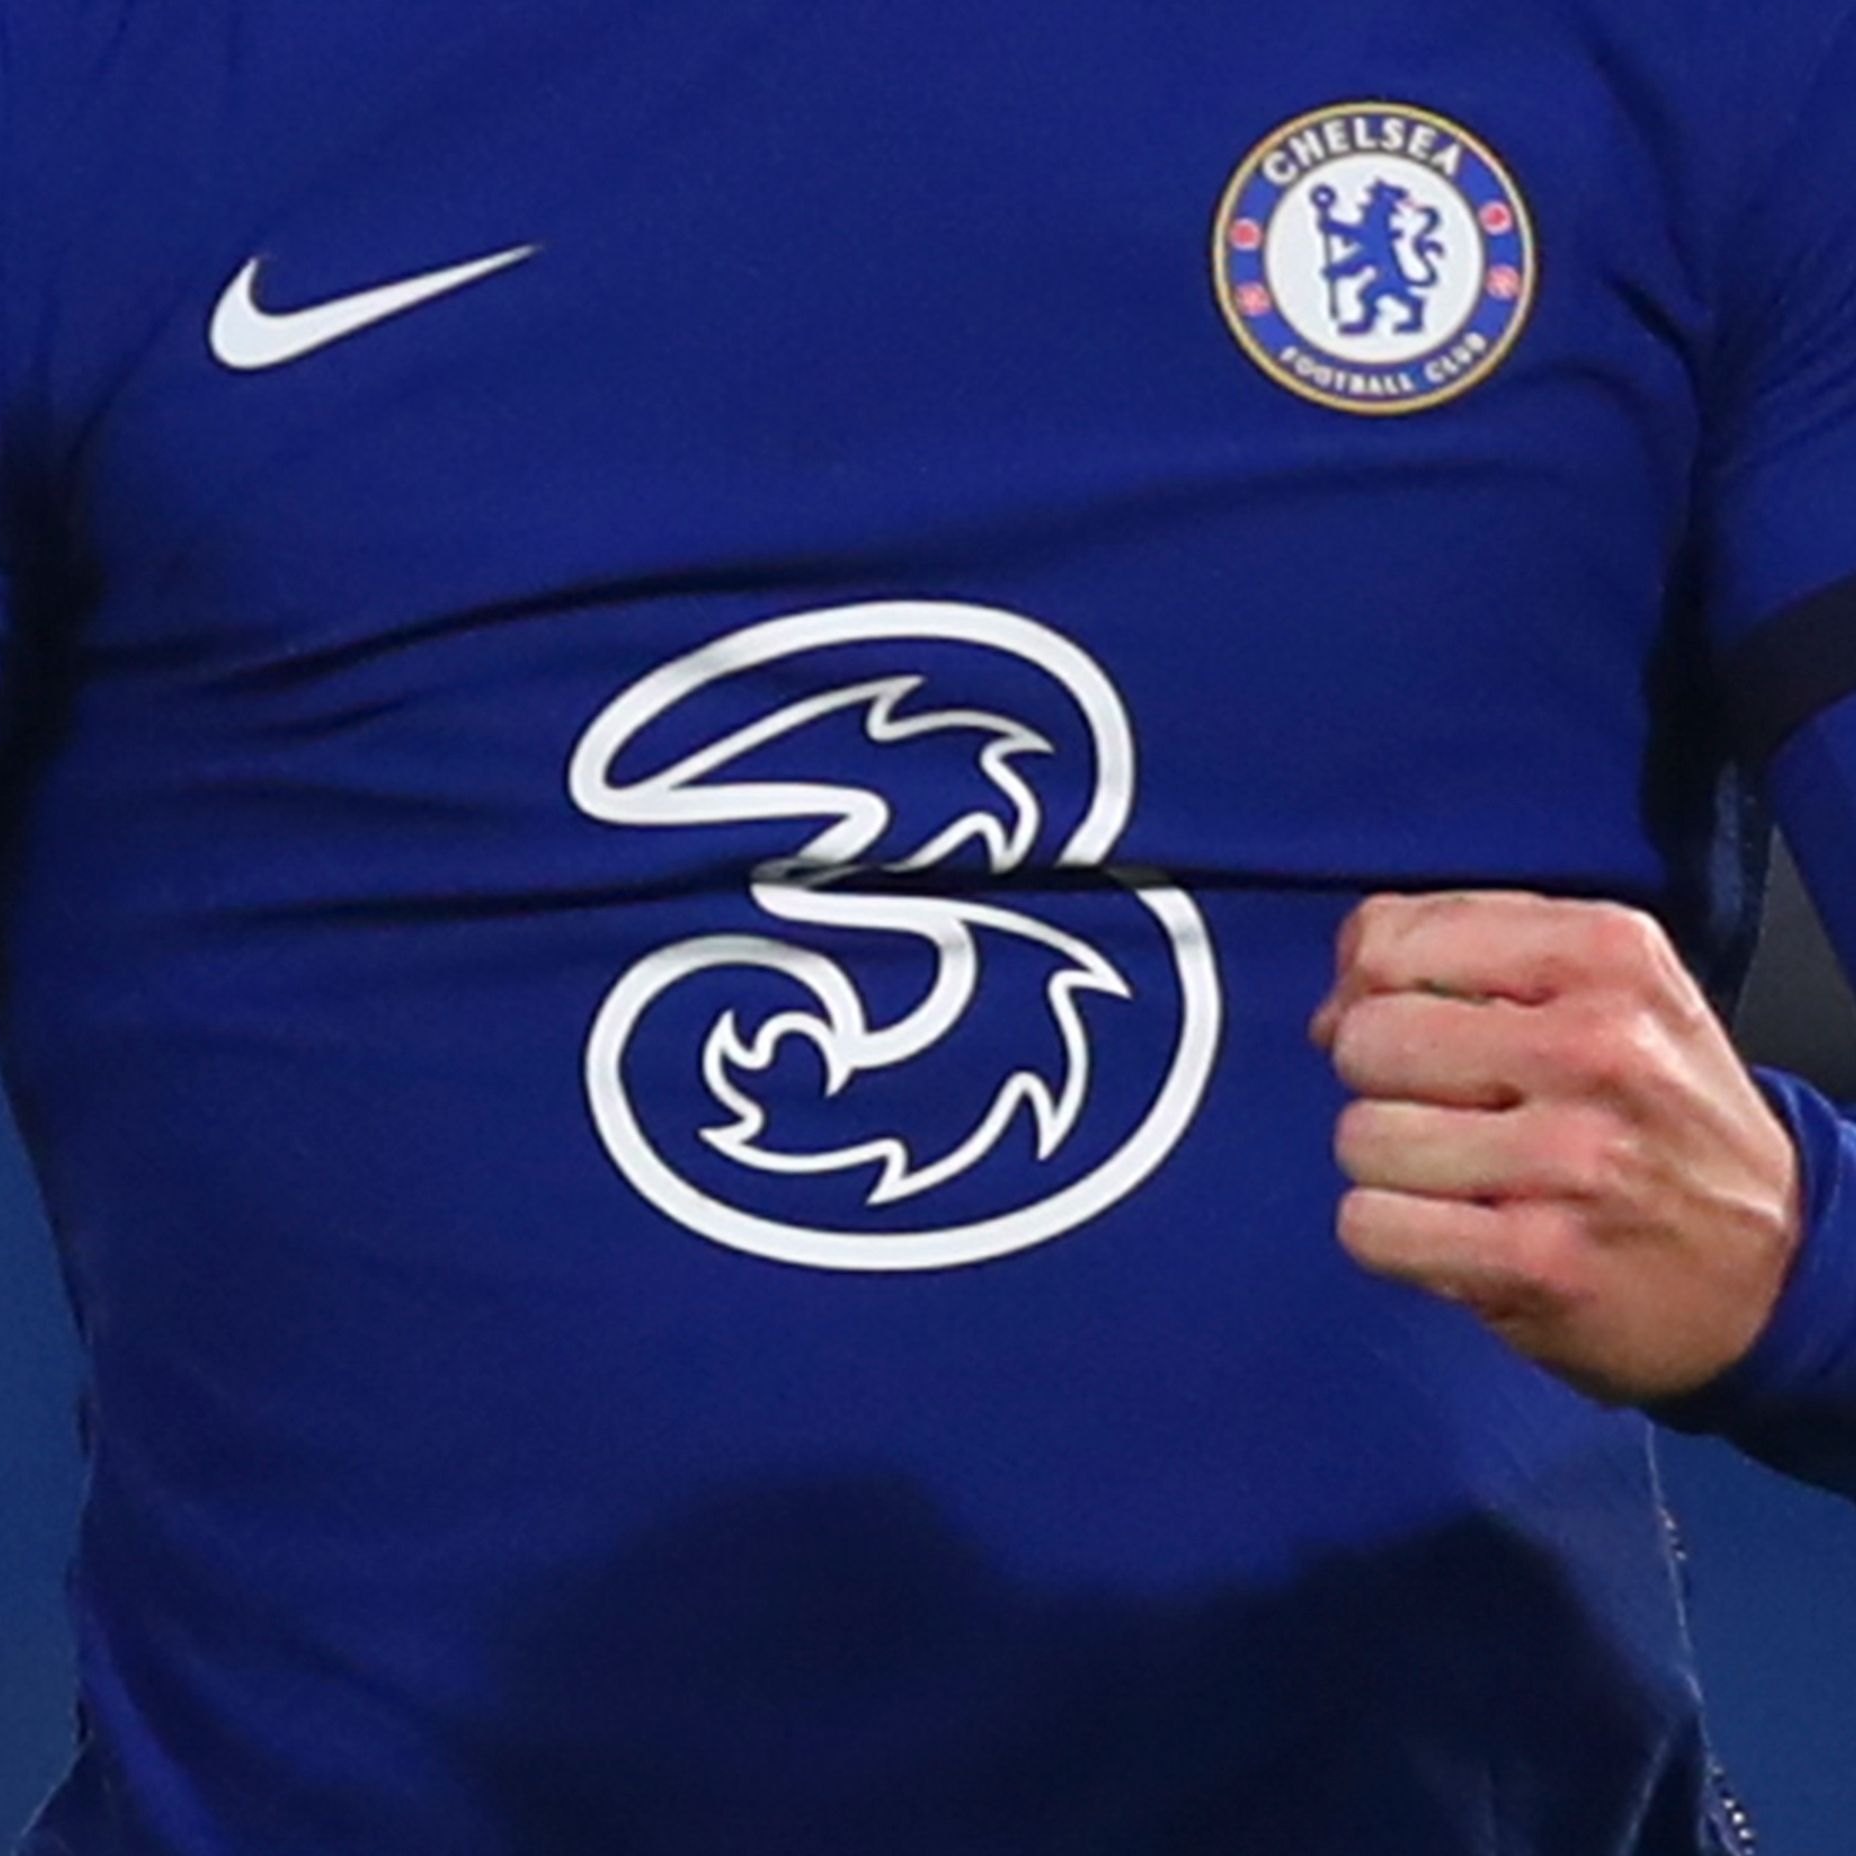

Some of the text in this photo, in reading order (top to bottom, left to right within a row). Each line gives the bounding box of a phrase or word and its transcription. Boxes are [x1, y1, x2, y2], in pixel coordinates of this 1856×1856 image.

[1261, 116, 1464, 185] CHELSEA
[1280, 331, 1488, 396] FOOTBALL CLUB
[568, 600, 1222, 1273] 3
